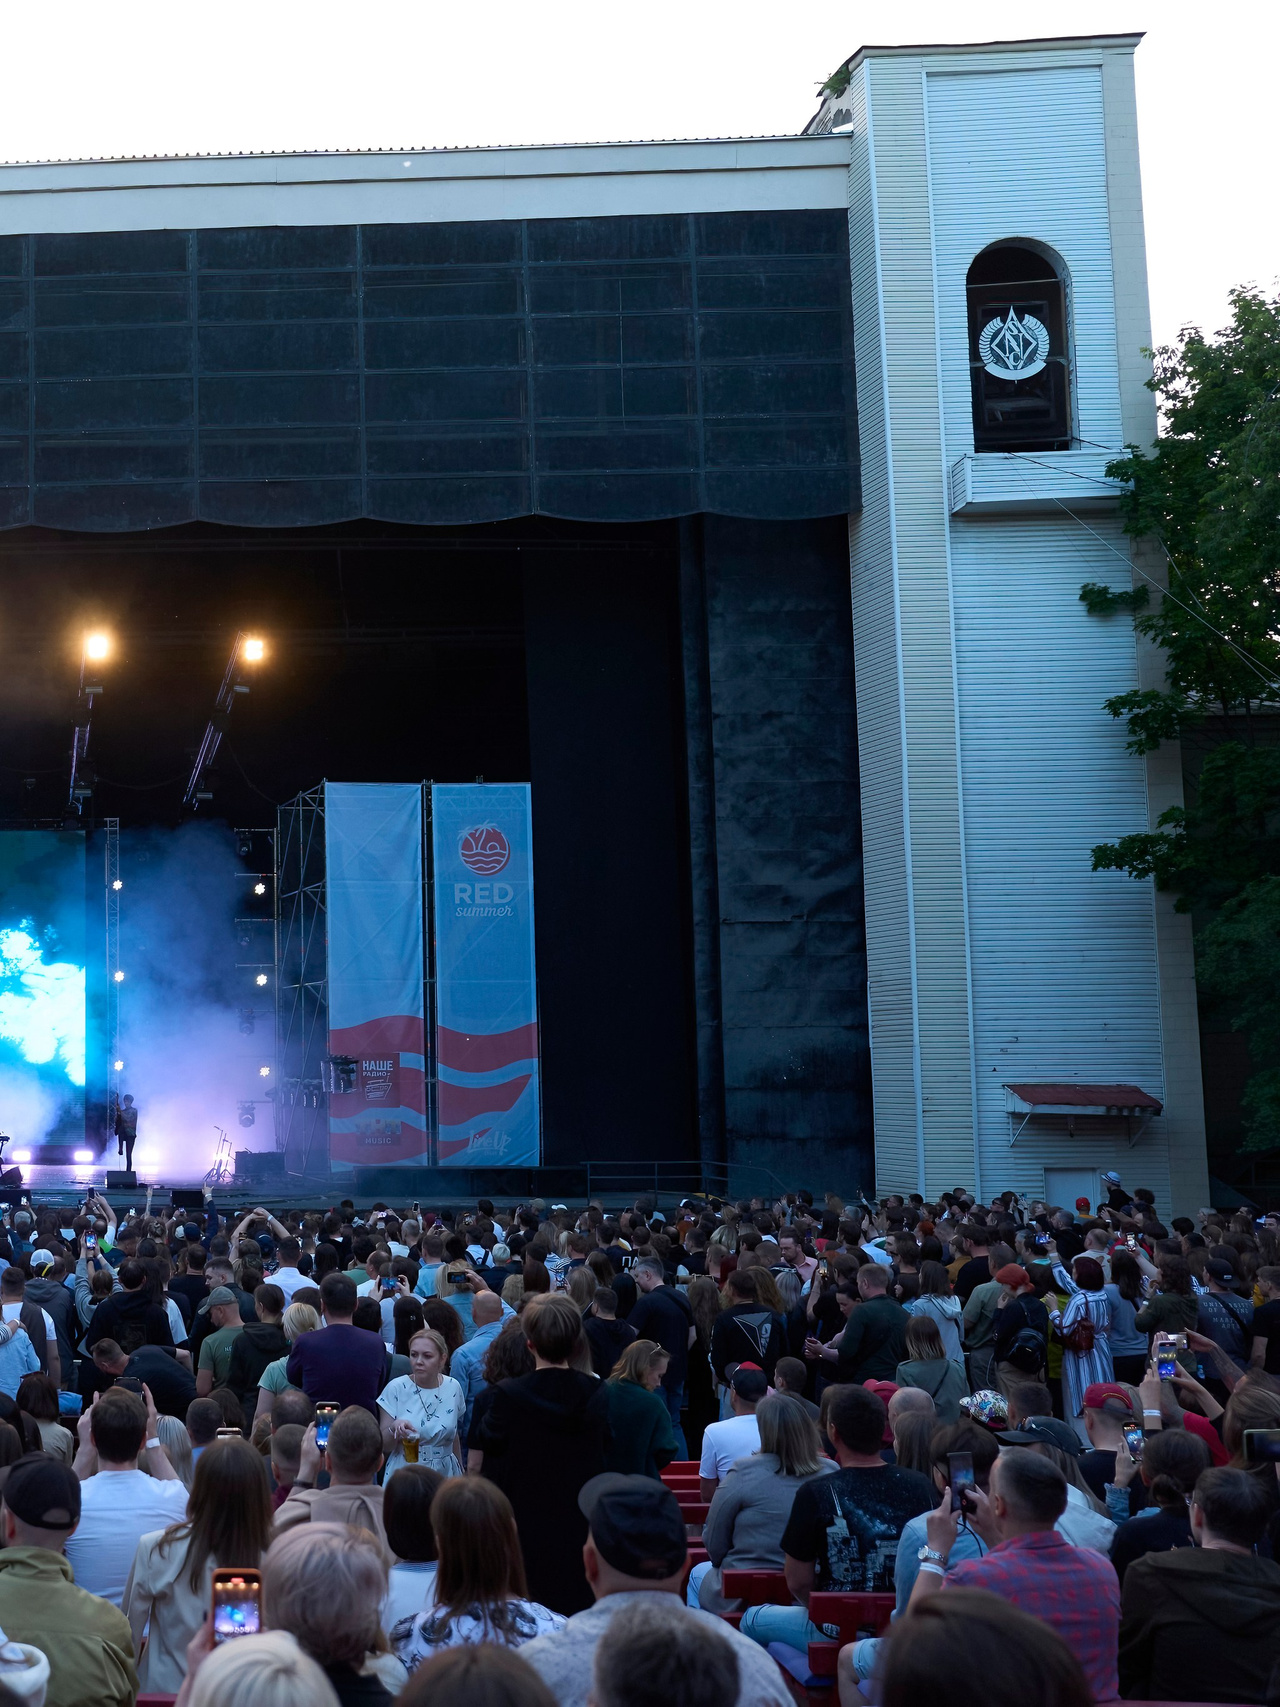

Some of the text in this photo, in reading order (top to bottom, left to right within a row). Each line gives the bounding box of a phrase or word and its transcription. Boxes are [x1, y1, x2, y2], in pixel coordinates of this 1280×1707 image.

[454, 883, 514, 904] RED
[455, 905, 514, 917] summer
[362, 1060, 394, 1071] НАШЕ
